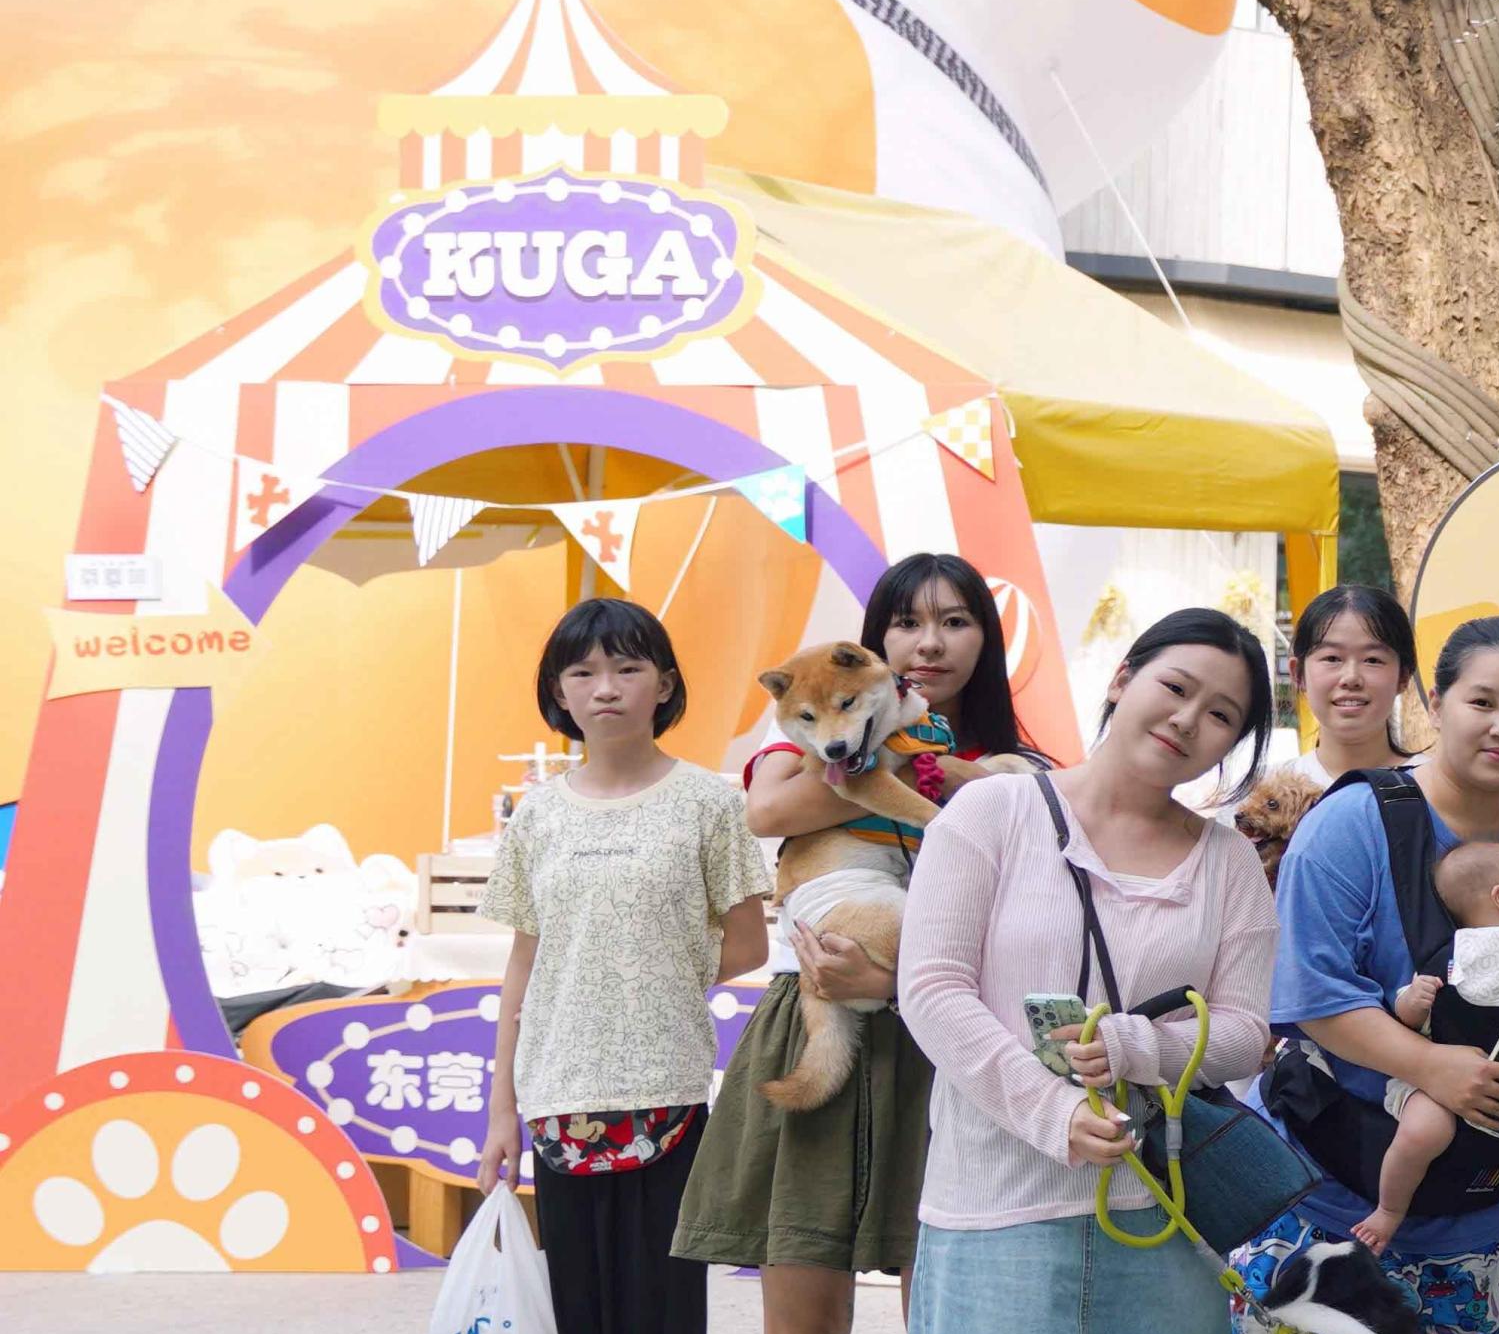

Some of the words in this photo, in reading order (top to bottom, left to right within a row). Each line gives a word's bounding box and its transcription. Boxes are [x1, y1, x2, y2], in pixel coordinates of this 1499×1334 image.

[422, 227, 711, 303] KUGA
[73, 625, 252, 659] welcome
[365, 1048, 497, 1113] 东莞
